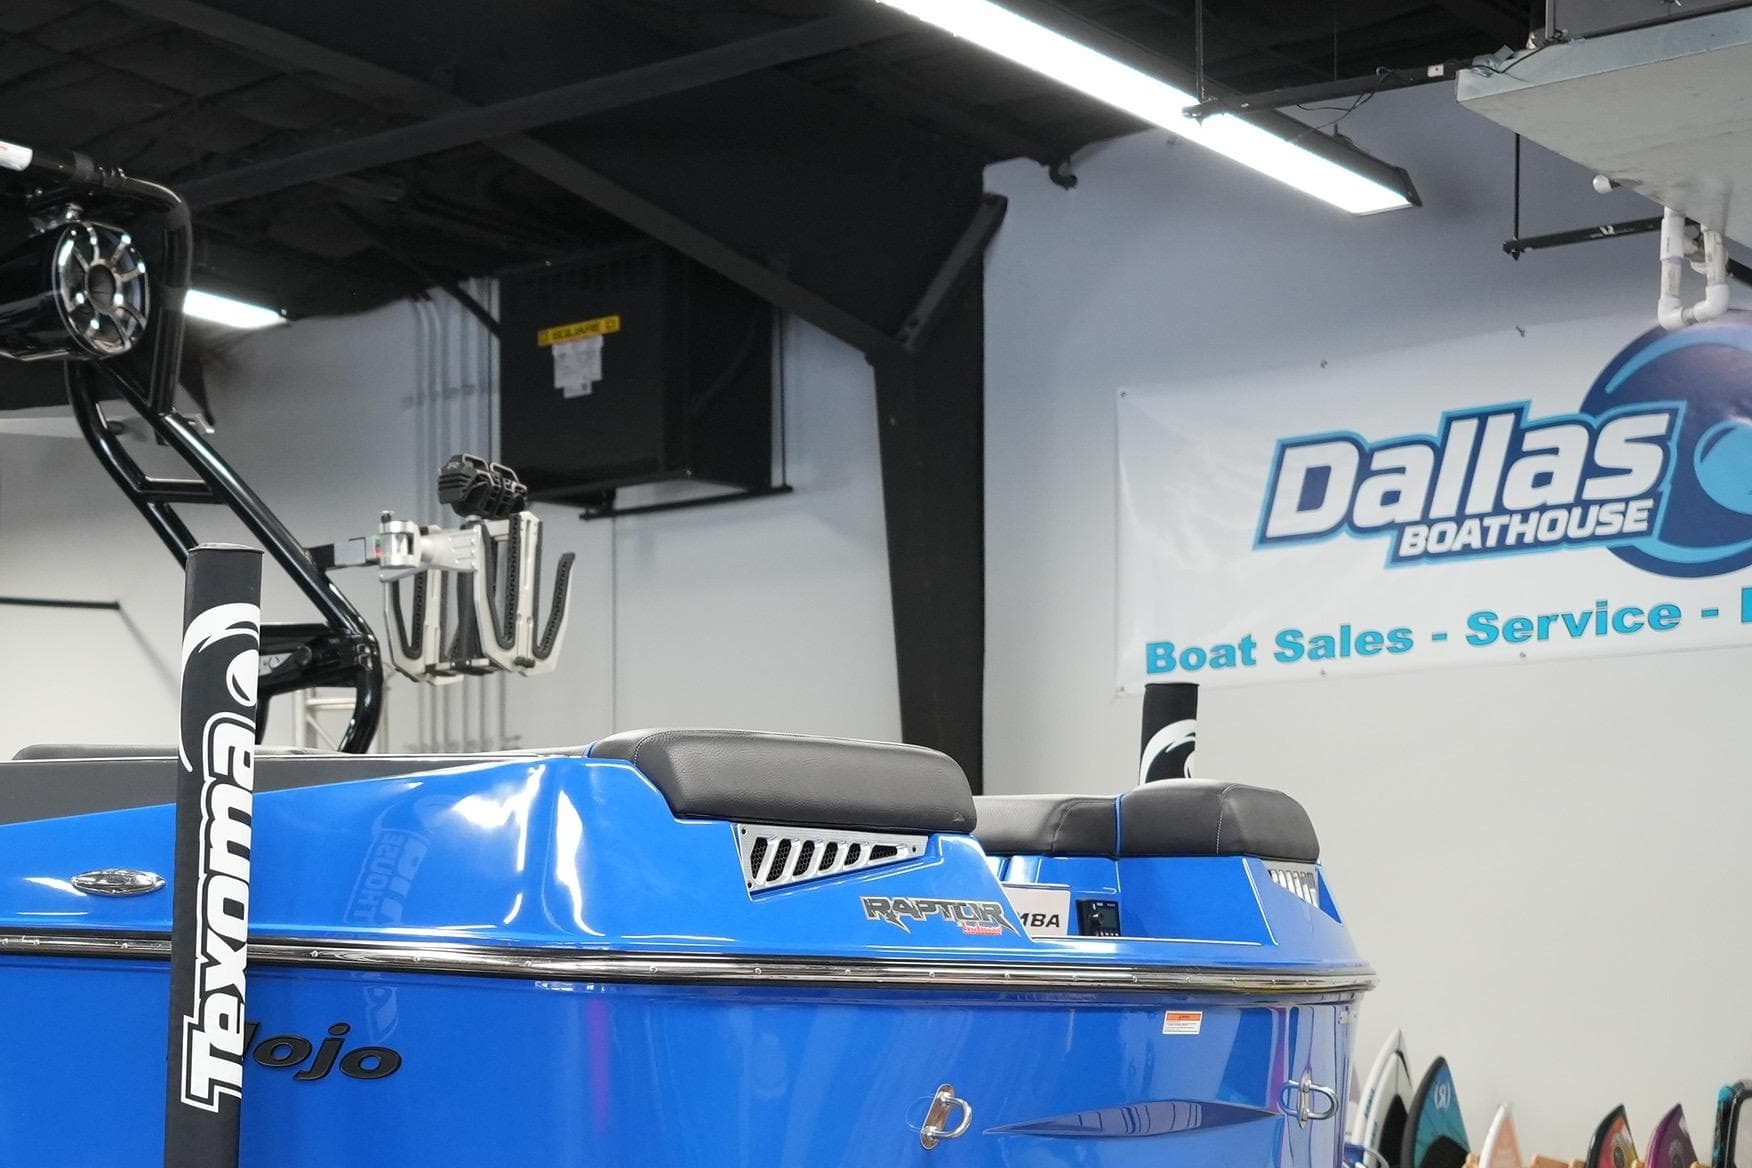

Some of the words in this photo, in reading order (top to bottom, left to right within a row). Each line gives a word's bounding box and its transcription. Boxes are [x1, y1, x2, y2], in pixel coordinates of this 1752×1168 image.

[1262, 409, 1675, 540] Dallas
[1398, 498, 1654, 558] BOATHOUSE
[1146, 632, 1257, 675] Boat
[1274, 622, 1414, 662] Sales
[1465, 600, 1682, 648] Service
[184, 715, 256, 1108] Texoma
[860, 896, 1021, 936] RAPTOR
[244, 1022, 402, 1080] ojo
